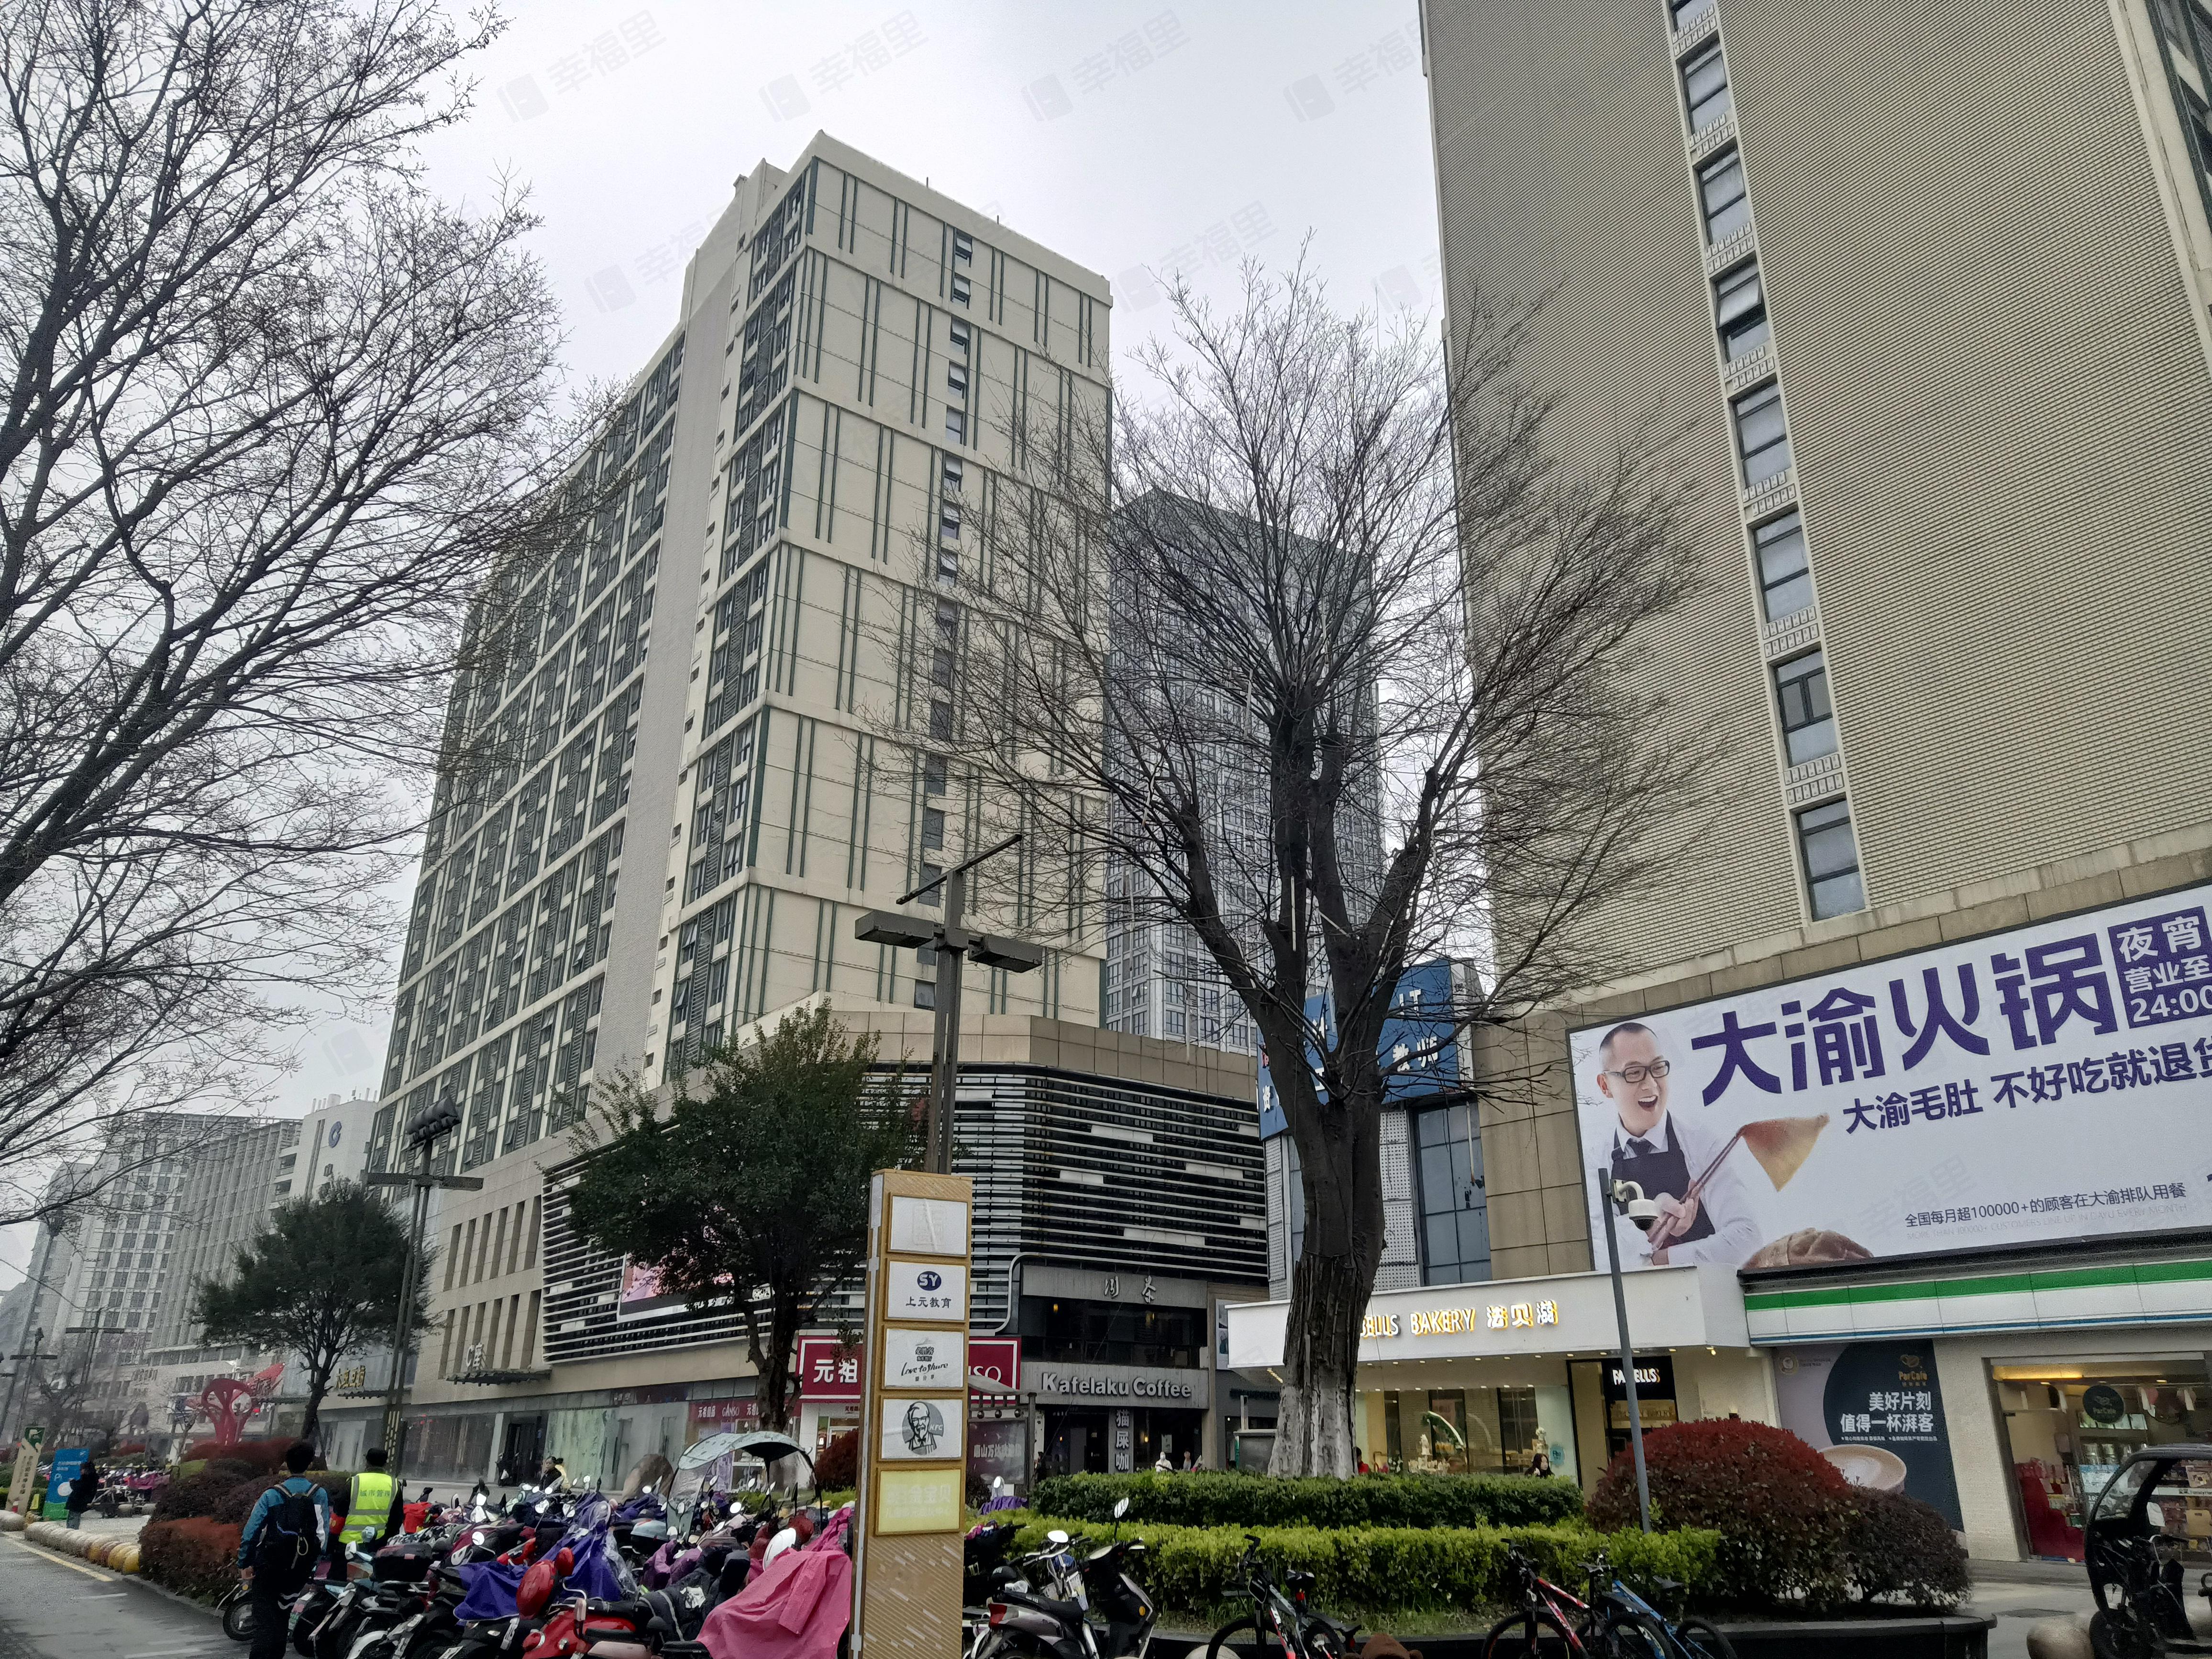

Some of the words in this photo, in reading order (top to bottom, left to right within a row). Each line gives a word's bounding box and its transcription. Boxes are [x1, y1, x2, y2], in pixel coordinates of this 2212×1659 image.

[2117, 916, 2203, 963] 夜宵
[2124, 955, 2212, 994] 营业至
[1691, 933, 2118, 1107] 大渝火锅
[1842, 1078, 1983, 1135] 大渝毛肚
[1904, 1182, 2187, 1228] 全国每月超100000+的顾客在大渝排队用餐
[919, 1274, 938, 1286] SY
[905, 1296, 951, 1309] 上元教育
[1486, 1299, 1559, 1329] 法贝滋
[1409, 1308, 1476, 1336] BAKERY
[466, 1342, 483, 1367] C座
[813, 1358, 858, 1383] 元祖
[1041, 1372, 1129, 1395] Kafelaku
[1133, 1377, 1192, 1397] Coffee
[1869, 1391, 1932, 1412] 美好片刻
[1840, 1413, 1934, 1433] 值得一杯湃客
